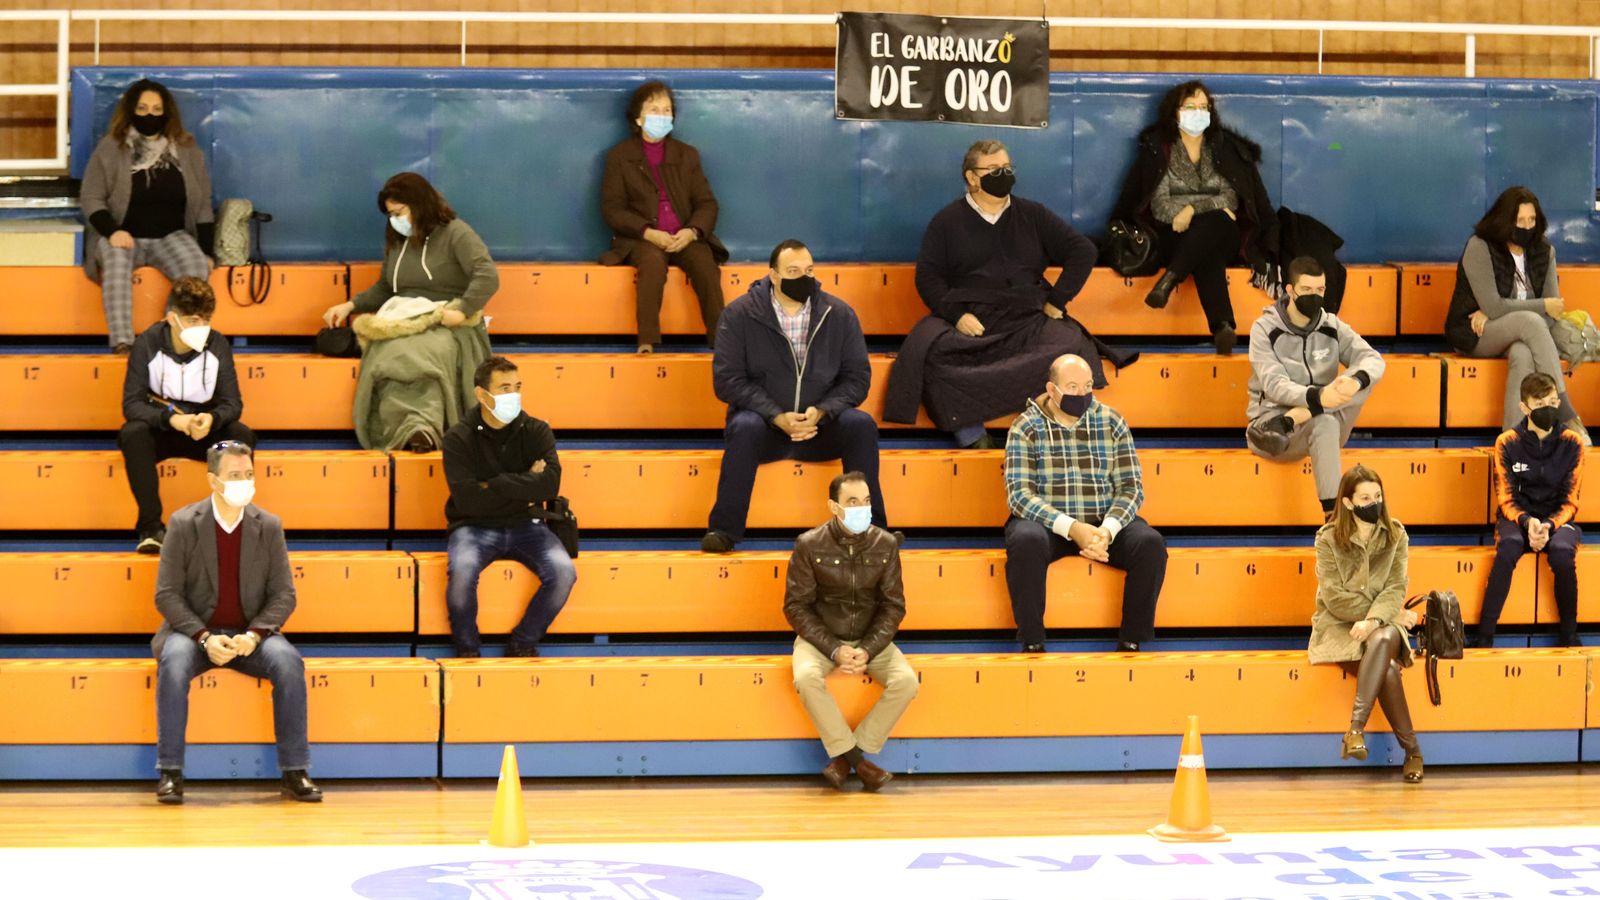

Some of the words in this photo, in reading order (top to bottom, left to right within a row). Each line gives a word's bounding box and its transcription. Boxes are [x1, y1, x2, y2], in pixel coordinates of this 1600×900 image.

[870, 32, 895, 58] EL
[901, 34, 1012, 64] GARBANZO
[869, 64, 923, 109] DE
[944, 68, 1013, 113] ORO
[1159, 366, 1171, 380] 6
[1461, 365, 1478, 380] 12
[1203, 463, 1214, 477] 6
[1410, 462, 1428, 476] 10
[718, 565, 731, 579] 5
[1246, 563, 1258, 577] 6
[1456, 560, 1475, 575] 10
[752, 671, 765, 687] 5
[1075, 669, 1087, 684] 2
[1288, 667, 1300, 682] 6
[1504, 664, 1522, 679] 10
[1274, 868, 1473, 885] de
